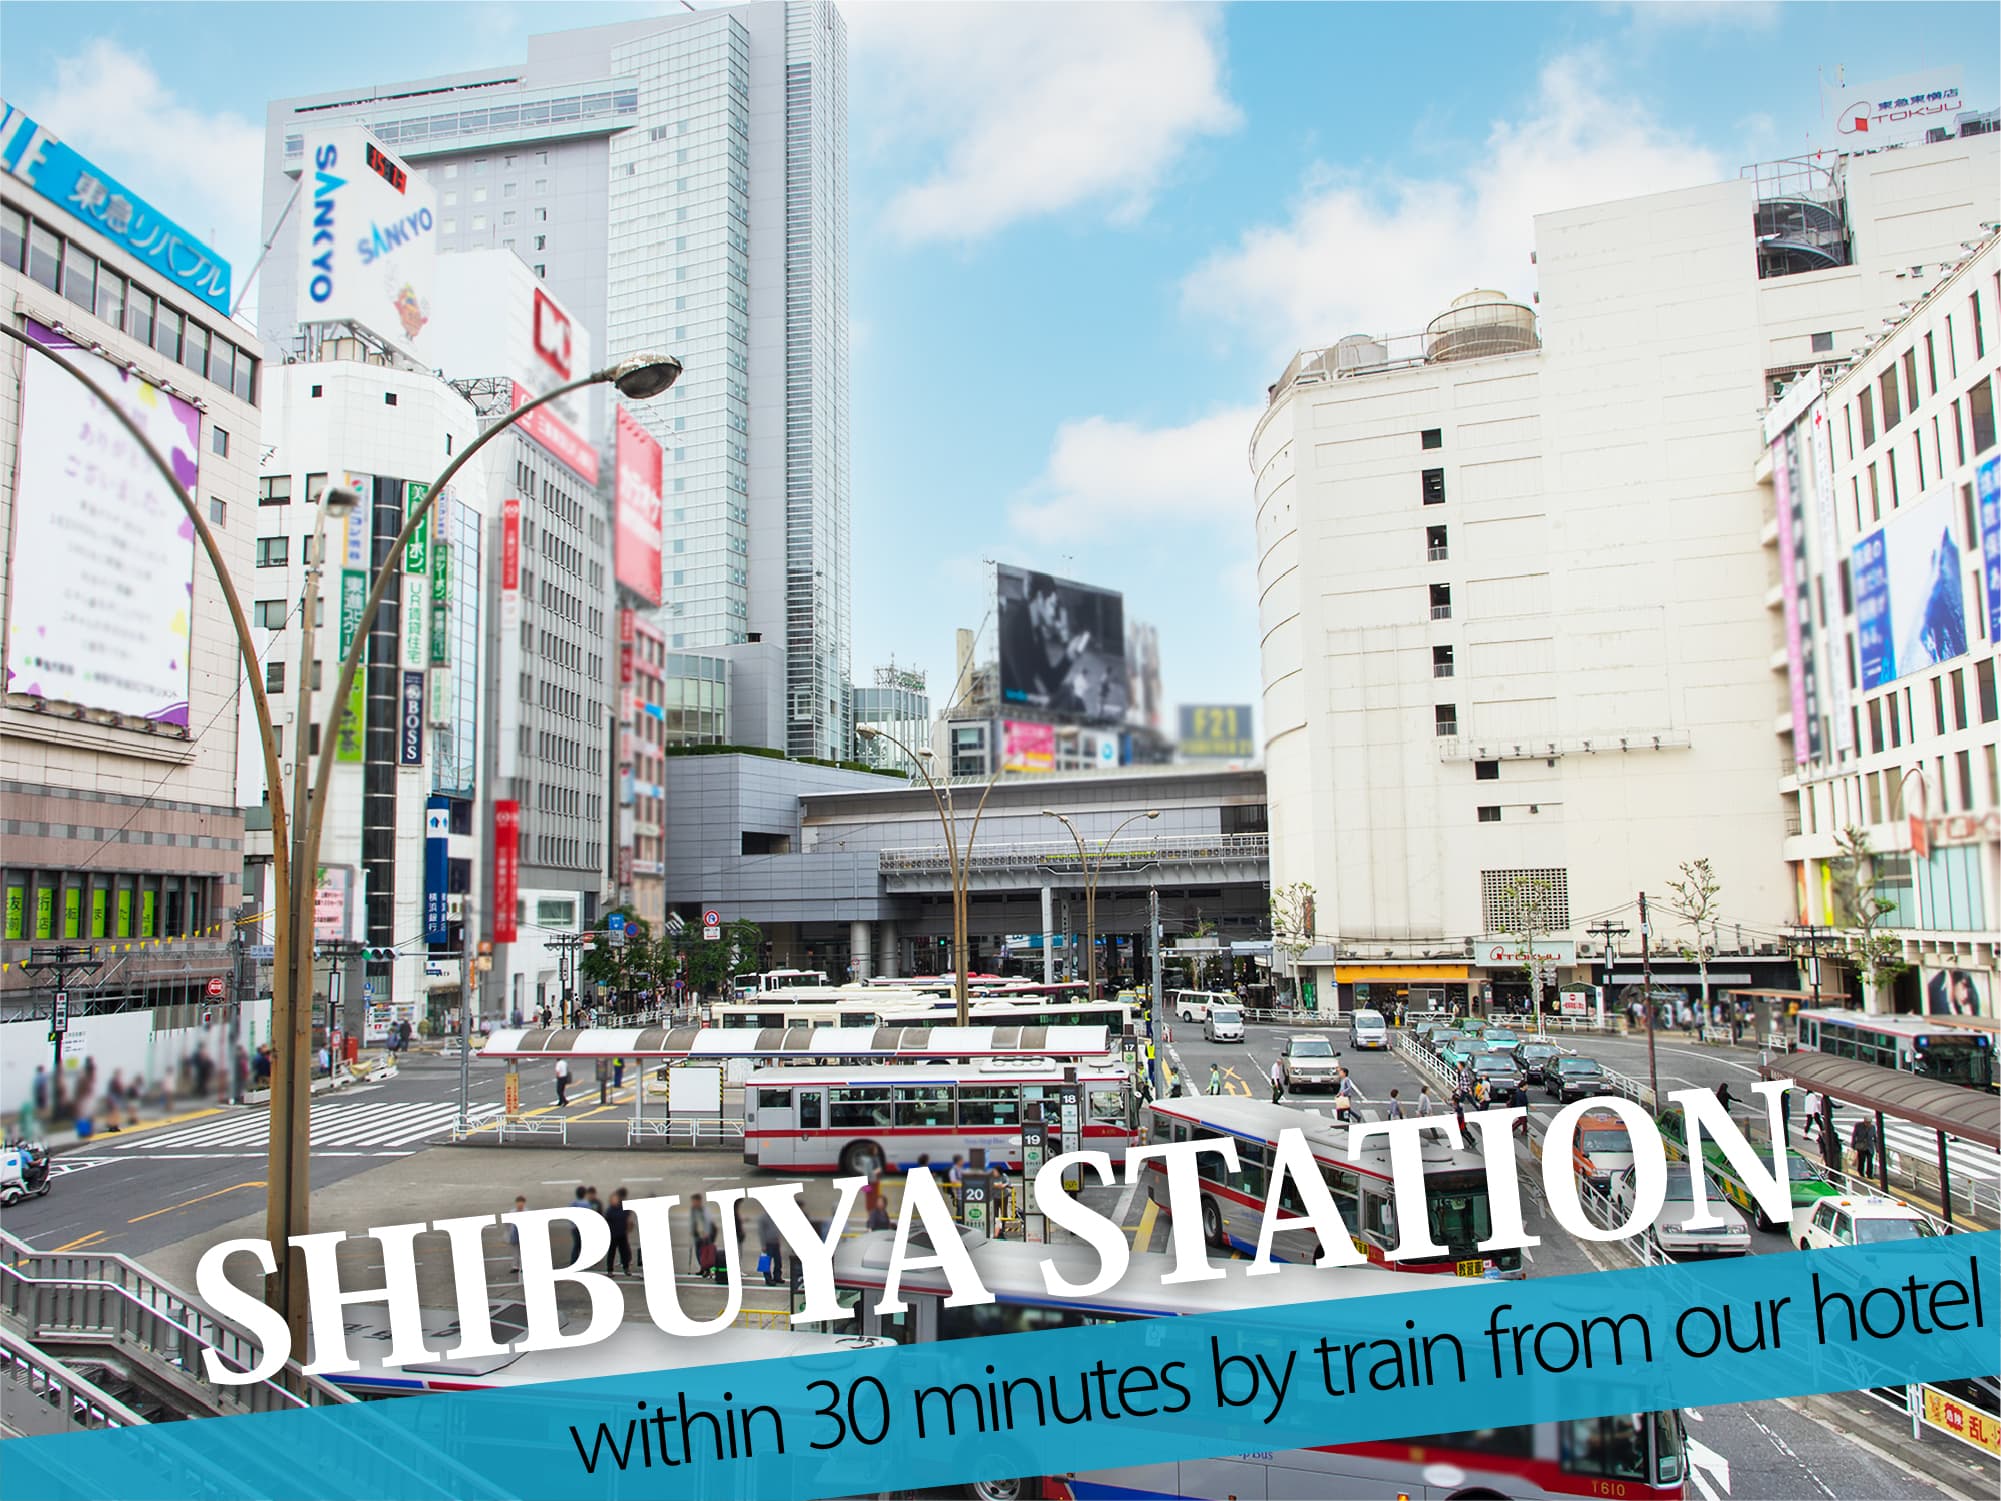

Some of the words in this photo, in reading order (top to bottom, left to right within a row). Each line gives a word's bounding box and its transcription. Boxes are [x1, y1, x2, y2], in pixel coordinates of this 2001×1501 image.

[1871, 100, 1963, 124] TOKYU
[1877, 87, 1959, 112] 東急東横店
[67, 169, 226, 297] 東急リバブル
[309, 144, 348, 303] SANKYO
[357, 206, 433, 265] SANKYO
[408, 581, 422, 665] UR賃貸住宅
[406, 700, 420, 760] BOSS
[1193, 706, 1237, 738] F21
[428, 892, 438, 932] 横浜銀行
[1124, 1044, 1136, 1052] 17
[1062, 1094, 1077, 1104] 18
[1024, 1134, 1041, 1145] 19
[966, 1188, 985, 1201] 20
[1591, 1480, 1627, 1498] T610
